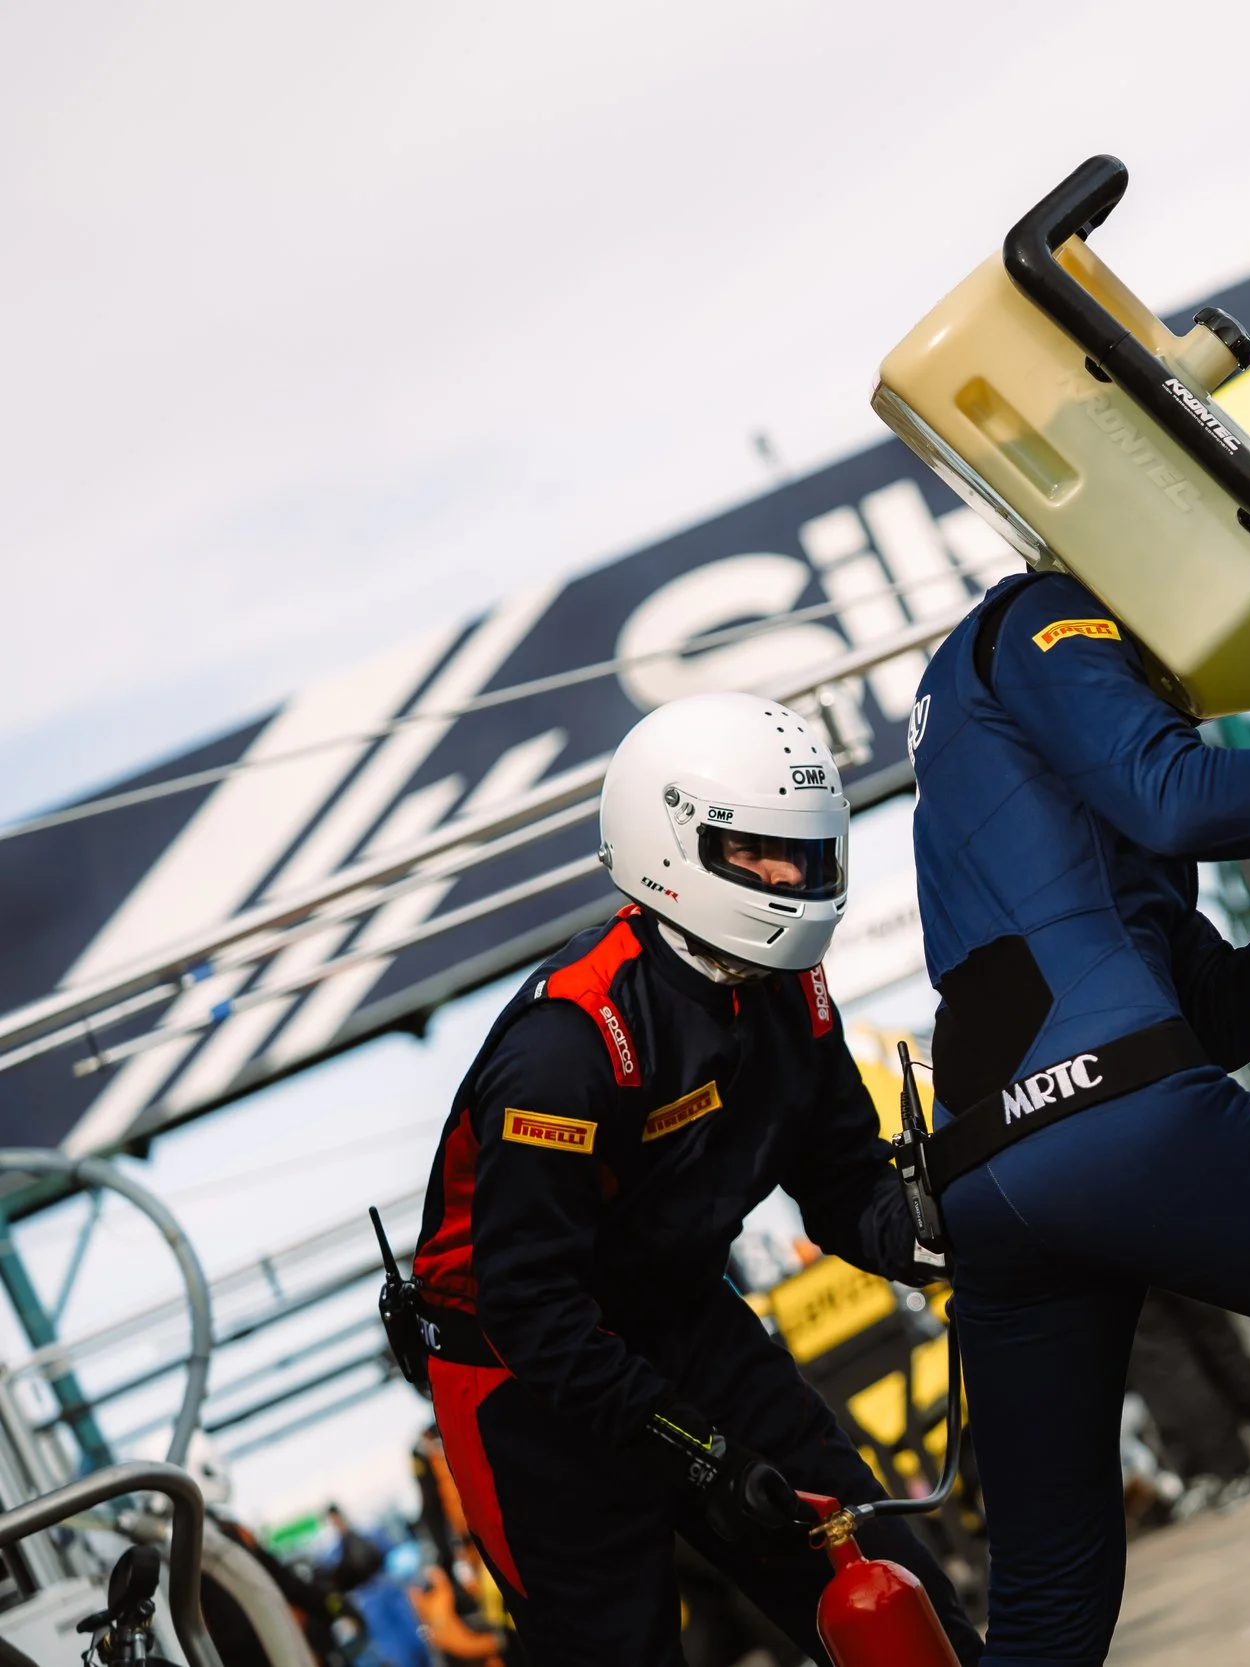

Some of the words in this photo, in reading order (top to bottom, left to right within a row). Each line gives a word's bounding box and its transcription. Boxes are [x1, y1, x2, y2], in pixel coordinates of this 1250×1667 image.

[1164, 378, 1242, 451] KRONTEC
[1041, 622, 1113, 645] PIRELLI
[791, 769, 826, 785] OMP
[707, 808, 734, 822] OMP
[600, 1005, 634, 1075] sparco
[1001, 1053, 1103, 1126] MRTC
[646, 1090, 712, 1135] PIRELLI
[512, 1117, 588, 1146] PIRELLI
